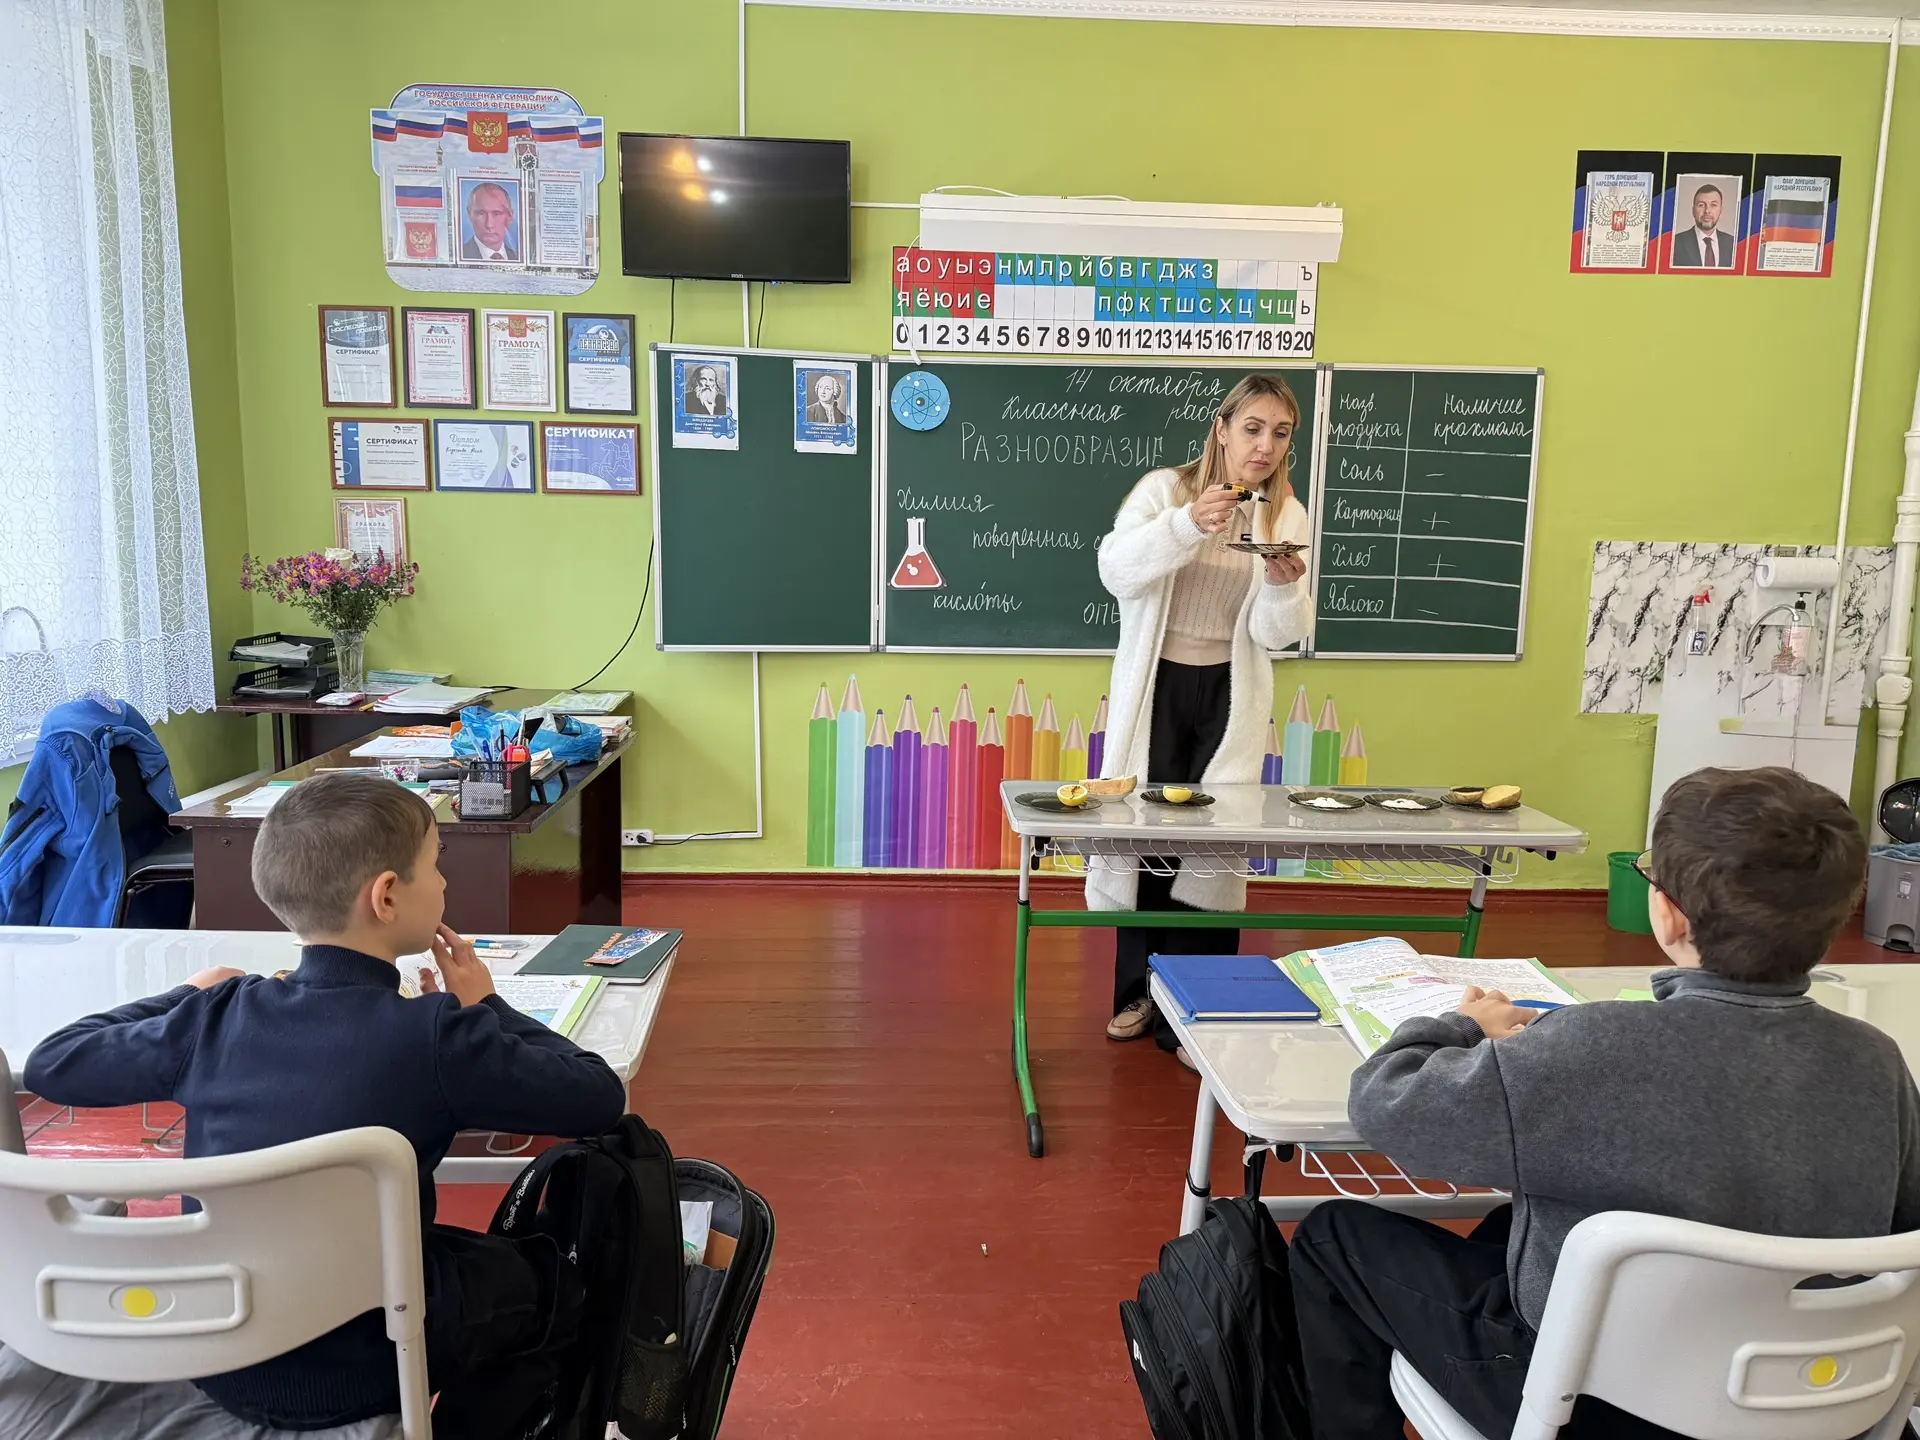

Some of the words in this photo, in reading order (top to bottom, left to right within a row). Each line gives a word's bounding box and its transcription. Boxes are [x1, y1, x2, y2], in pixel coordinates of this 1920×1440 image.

[414, 90, 502, 100] ГОСУДАРСТВЕННАЯ
[504, 93, 560, 102] СИМВОЛИКА
[428, 100, 489, 108] РОССИЙСКОЙ
[491, 102, 546, 110] ФЕДЕРАЦИИ
[897, 257, 910, 273] а
[916, 257, 931, 273] о
[938, 257, 950, 279] у
[956, 257, 973, 274] ы
[978, 258, 991, 274] э
[1000, 258, 1012, 275] н
[1017, 259, 1034, 276] м
[1038, 259, 1053, 276] л
[1059, 260, 1072, 282] р
[1080, 256, 1092, 276] й
[1100, 256, 1114, 272] б
[1120, 262, 1133, 276] в
[1142, 262, 1151, 277] г
[1159, 263, 1175, 282] д
[1178, 263, 1196, 279] ж
[1202, 264, 1213, 280] з
[1301, 266, 1312, 281] ъ
[897, 291, 910, 307] я
[916, 288, 930, 308] ё
[934, 292, 952, 308] ю
[958, 293, 970, 309] и
[977, 293, 991, 310] е
[1099, 296, 1111, 312] п
[1116, 292, 1134, 317] ф
[1140, 297, 1151, 312] к
[1160, 297, 1172, 313] т
[1177, 298, 1194, 313] ш
[1199, 298, 1212, 313] с
[1219, 298, 1232, 313] х
[1239, 298, 1253, 318] ц
[1260, 299, 1272, 314] ч
[1277, 300, 1294, 318] щ
[1301, 301, 1310, 314] ь
[498, 340, 541, 348] ГРАМОТА
[896, 323, 908, 344] 0
[918, 324, 928, 343] 1
[937, 324, 950, 344] 2
[956, 325, 970, 345] 3
[976, 326, 990, 346] 4
[997, 326, 1010, 345] 5
[1017, 327, 1030, 346] 6
[1037, 327, 1050, 346] 7
[1057, 327, 1070, 347] 8
[1077, 328, 1090, 347] 9
[1095, 328, 1112, 348] 10
[1117, 329, 1131, 348] 11
[1135, 329, 1152, 349] 12
[1155, 329, 1172, 349] 13
[1174, 330, 1192, 350] 14
[1195, 330, 1212, 350] 15
[1215, 330, 1232, 350] 16
[1235, 330, 1253, 350] 17
[1255, 330, 1272, 350] 18
[1275, 331, 1293, 350] 19
[1294, 331, 1314, 351] 20
[1066, 368, 1094, 392] 14
[1108, 371, 1227, 408] октября
[1444, 392, 1526, 415] Наличие
[449, 434, 480, 443] Диплом
[545, 427, 634, 439] СЕРТИФИКАТ
[961, 421, 1164, 467] РАЗНООБРАЗИЕ
[1434, 421, 1533, 445] крахмала
[1340, 457, 1384, 482] Соль
[897, 486, 995, 512] Химия
[1331, 543, 1376, 567] Хлеб
[1323, 583, 1384, 614] Яблоко
